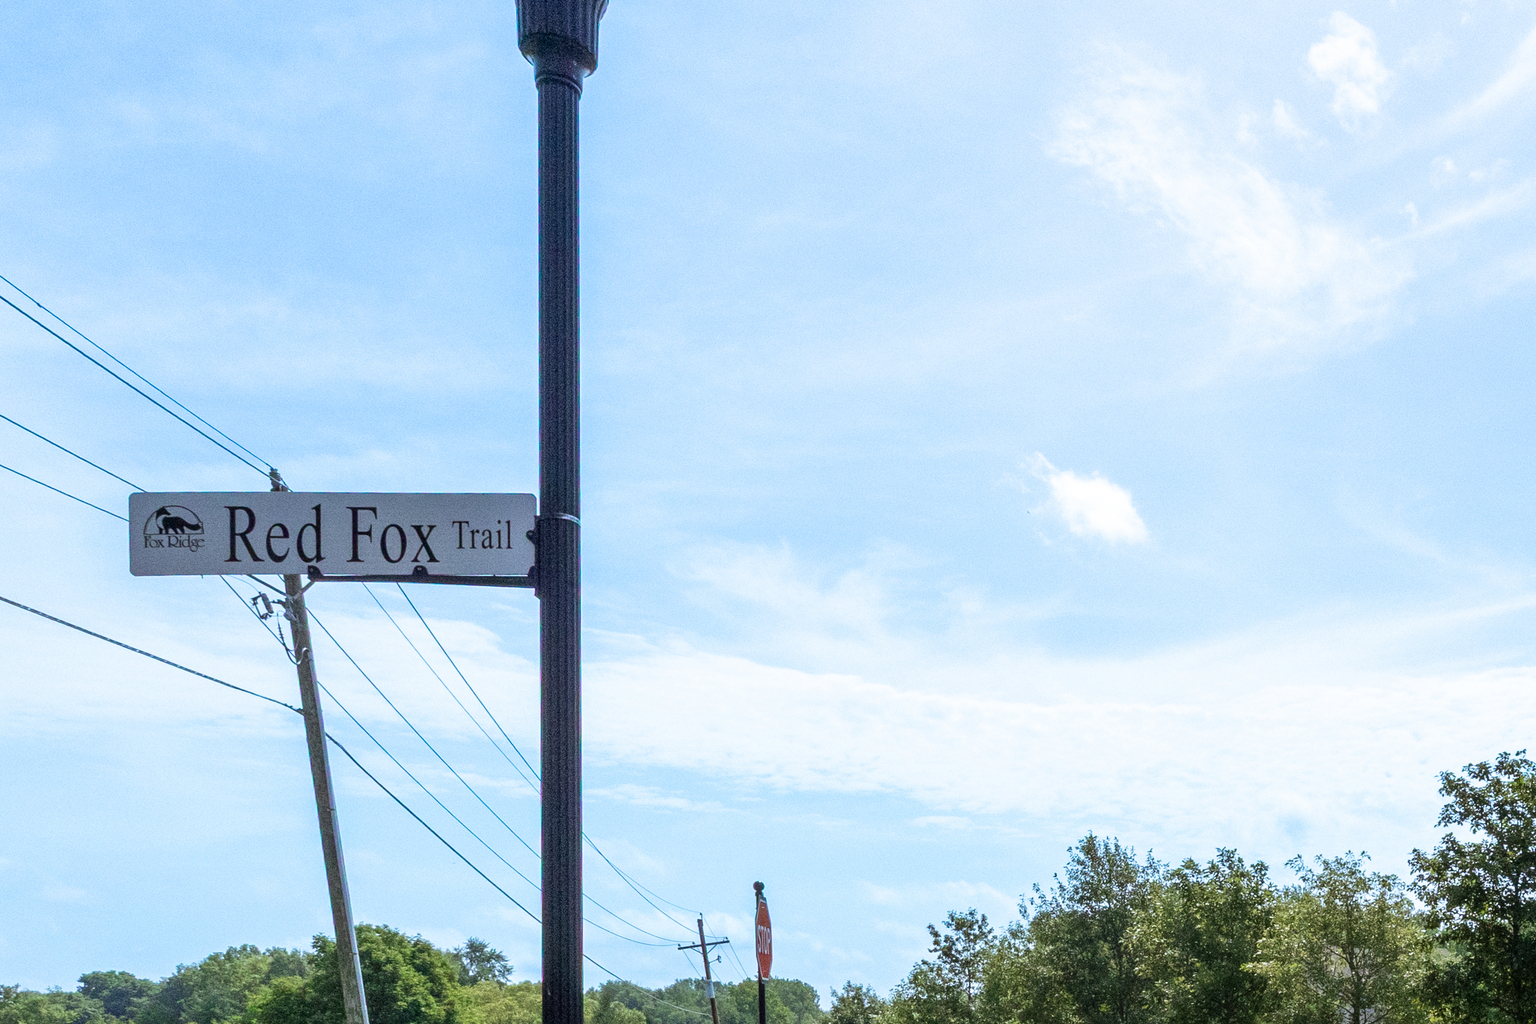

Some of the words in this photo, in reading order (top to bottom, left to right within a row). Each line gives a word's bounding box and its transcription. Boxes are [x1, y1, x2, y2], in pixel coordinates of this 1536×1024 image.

[143, 535, 164, 548] Fox
[167, 535, 206, 552] Ridge
[223, 503, 326, 563] Red
[346, 506, 440, 563] Fox
[452, 519, 513, 550] Trail
[757, 925, 771, 955] STOP
